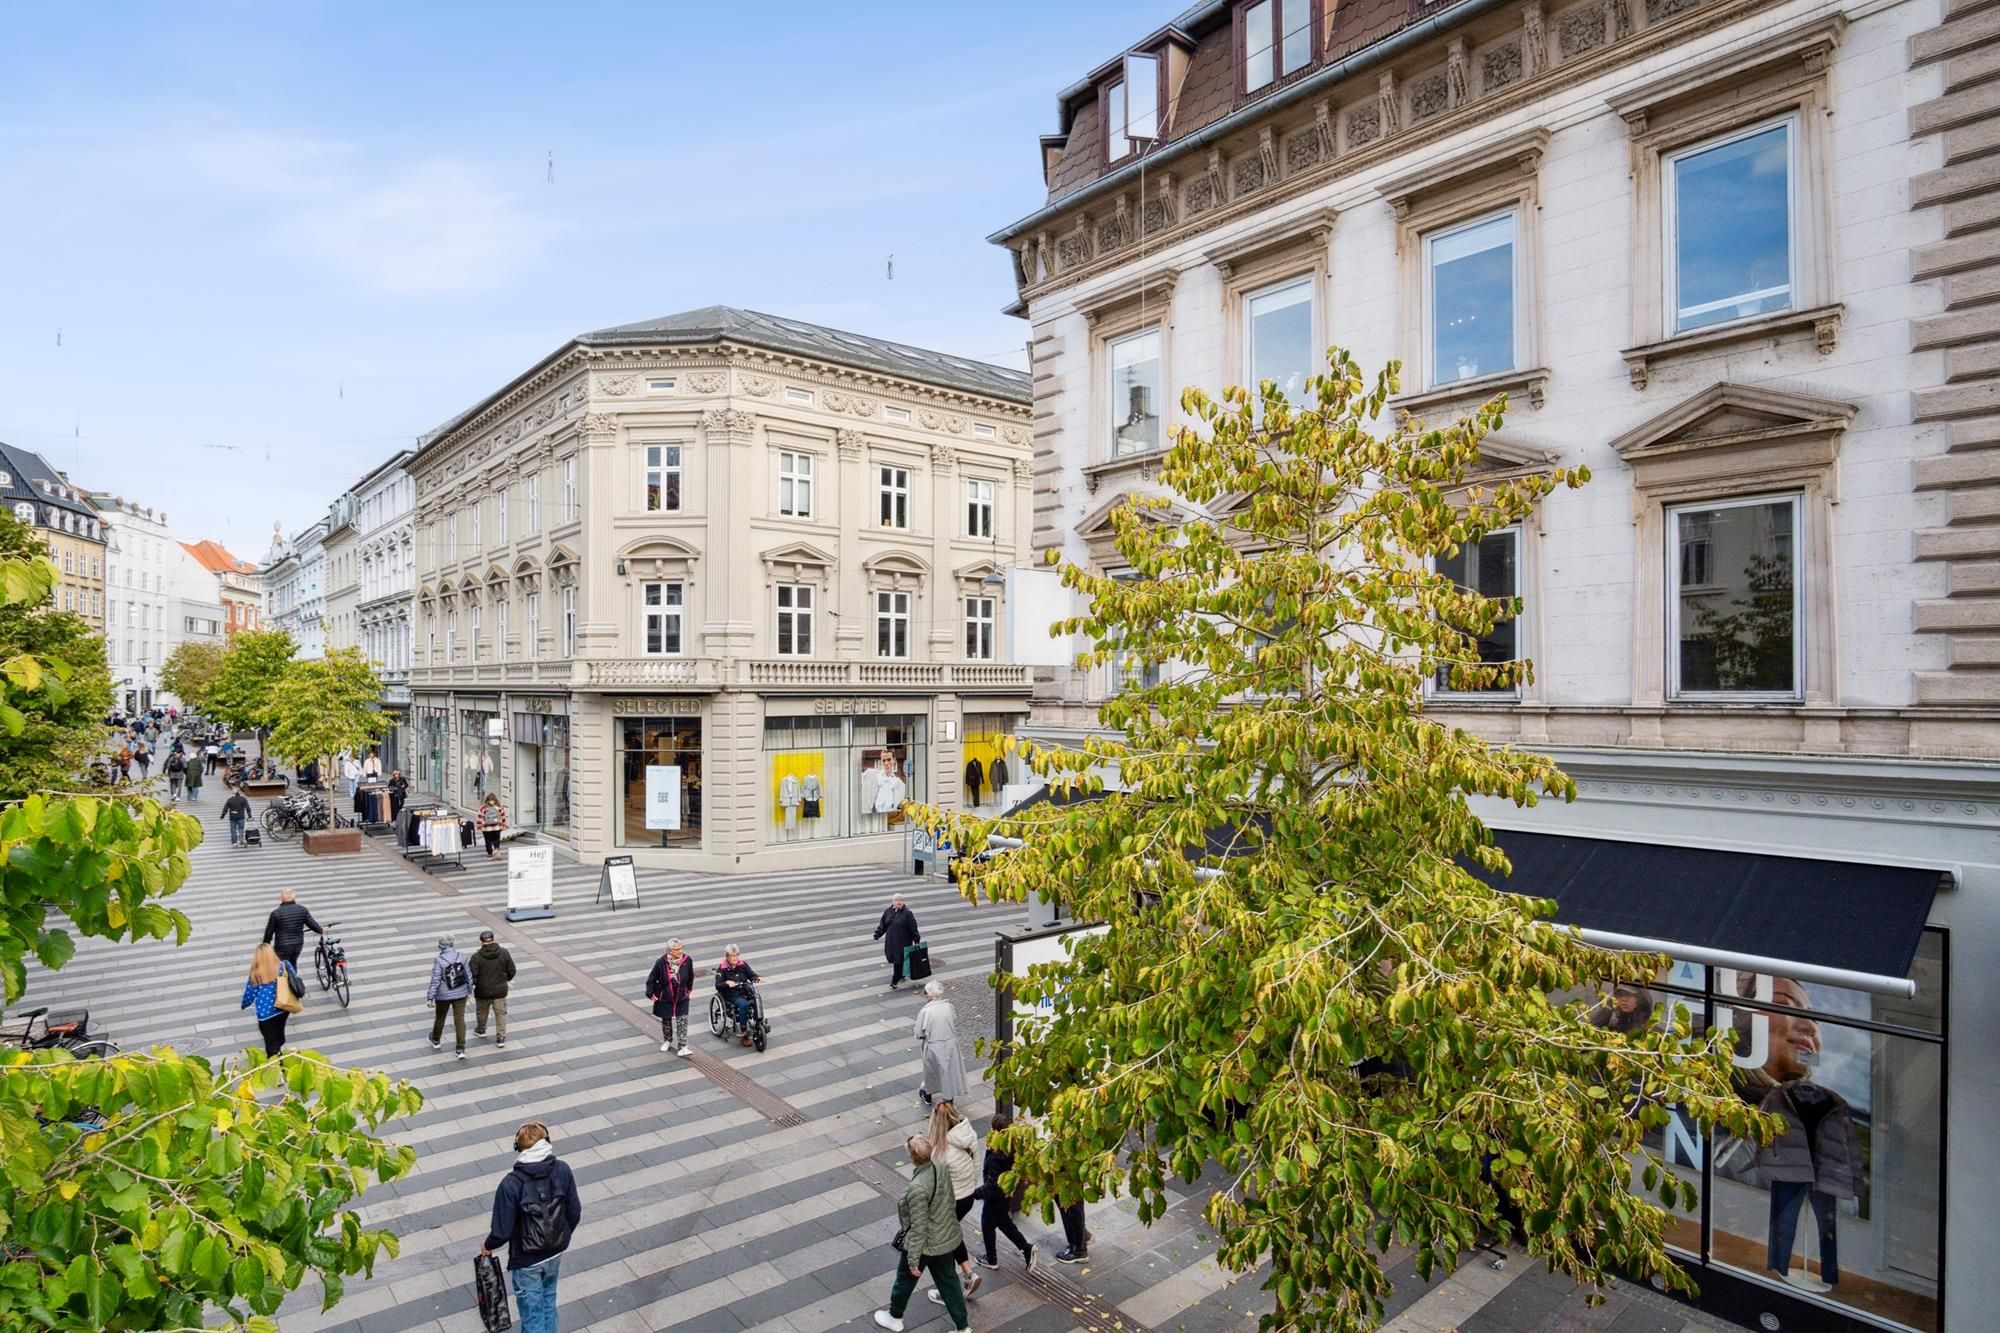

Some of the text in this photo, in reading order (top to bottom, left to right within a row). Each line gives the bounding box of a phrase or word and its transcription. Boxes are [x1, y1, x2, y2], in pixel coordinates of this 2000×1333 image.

[613, 698, 702, 714] SELECTED
[815, 698, 887, 713] SELECTED
[529, 849, 547, 860] Hej!
